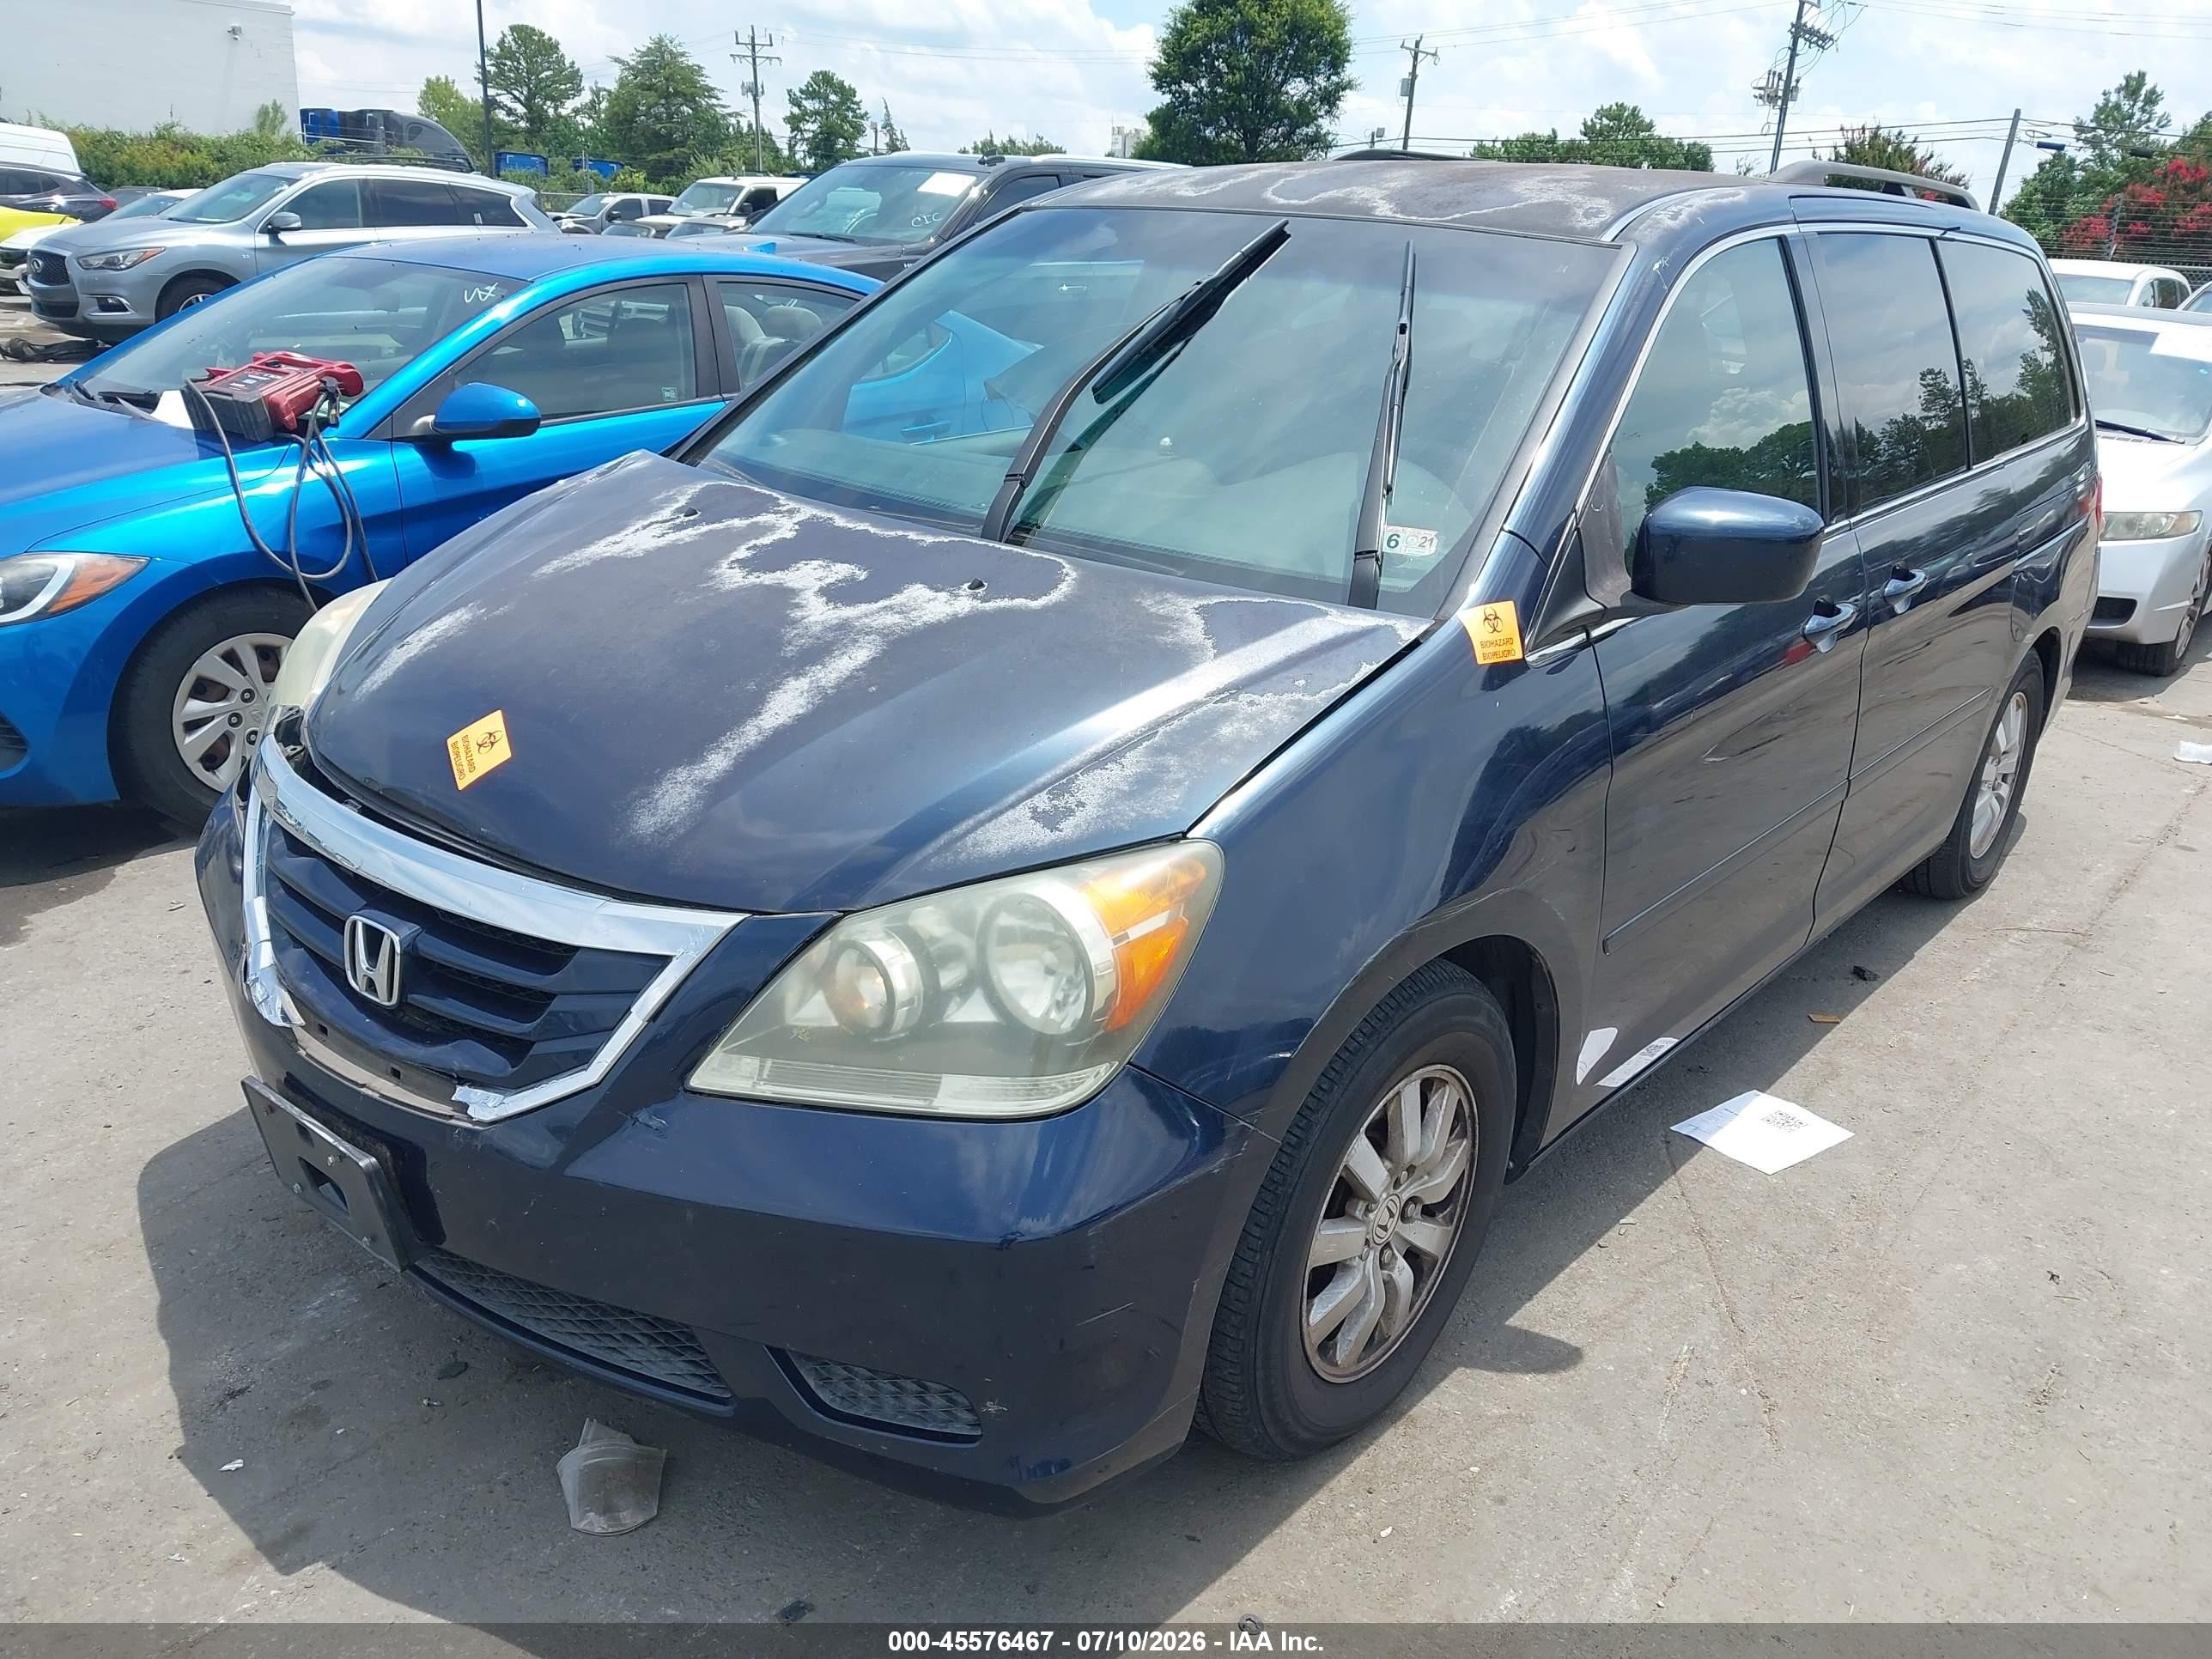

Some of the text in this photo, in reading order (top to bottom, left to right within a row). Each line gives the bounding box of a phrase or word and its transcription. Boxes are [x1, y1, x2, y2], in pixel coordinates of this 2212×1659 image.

[1386, 533, 1435, 550] 6 21
[1480, 637, 1514, 649] BIOHAZARD
[1482, 648, 1516, 661] BIOPELIGRO
[451, 740, 466, 781] BIOPELIGRO
[461, 734, 477, 774] BIOHAZARD
